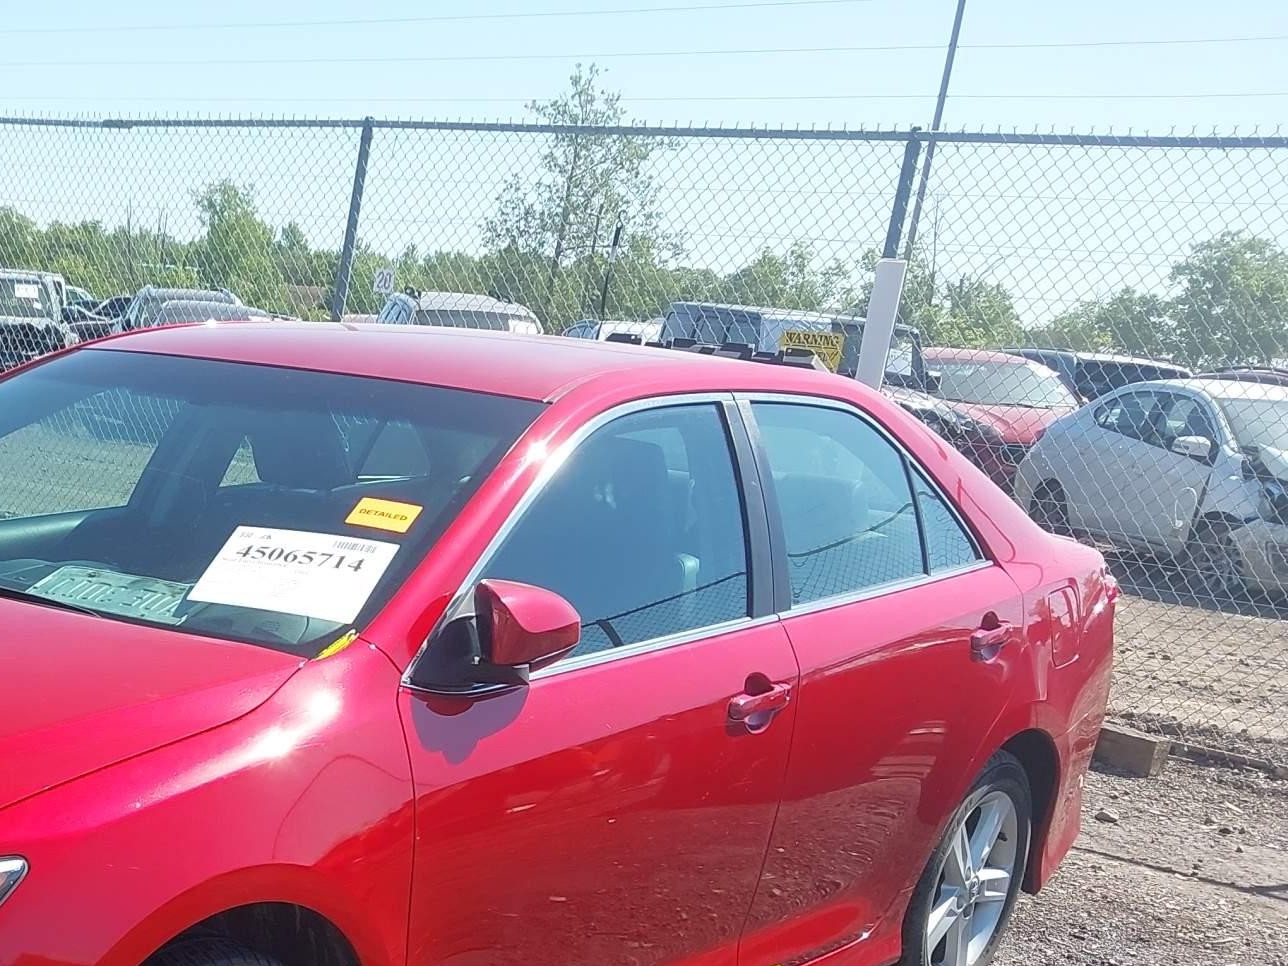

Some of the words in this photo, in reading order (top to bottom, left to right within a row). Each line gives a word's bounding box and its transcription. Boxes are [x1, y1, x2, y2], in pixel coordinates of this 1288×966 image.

[784, 331, 840, 347] WARNING
[359, 508, 409, 521] DETAILED
[236, 544, 365, 572] 45065714
